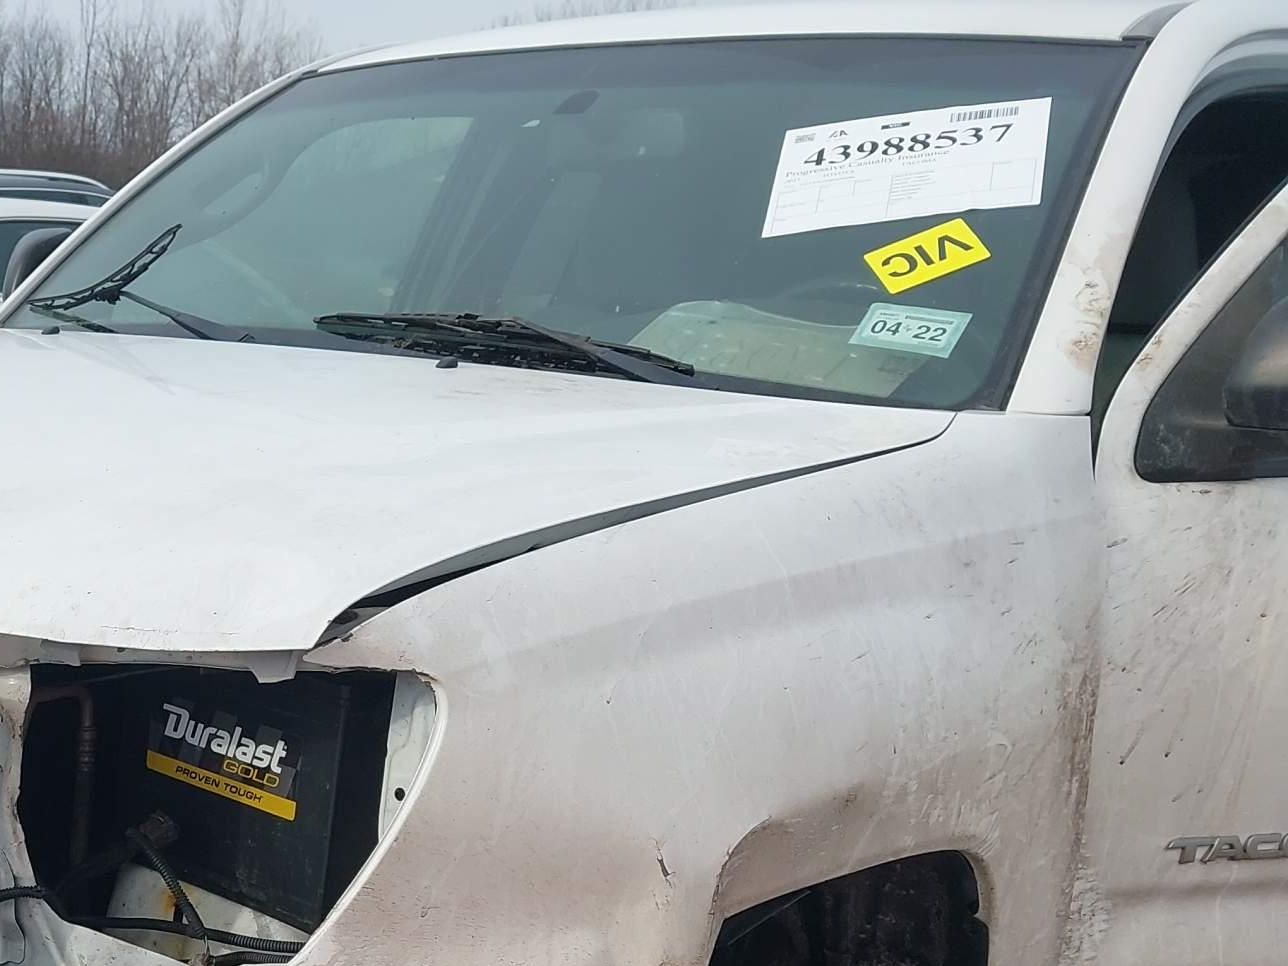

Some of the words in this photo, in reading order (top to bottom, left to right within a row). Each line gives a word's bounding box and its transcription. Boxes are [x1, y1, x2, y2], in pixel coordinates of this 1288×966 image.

[803, 123, 1014, 166] 43988537
[870, 320, 903, 336] 04
[912, 325, 947, 342] 22
[163, 703, 288, 774] Duralast
[175, 765, 220, 788] PROVEN
[224, 782, 264, 803] TOUGH
[223, 759, 279, 788] GOLD
